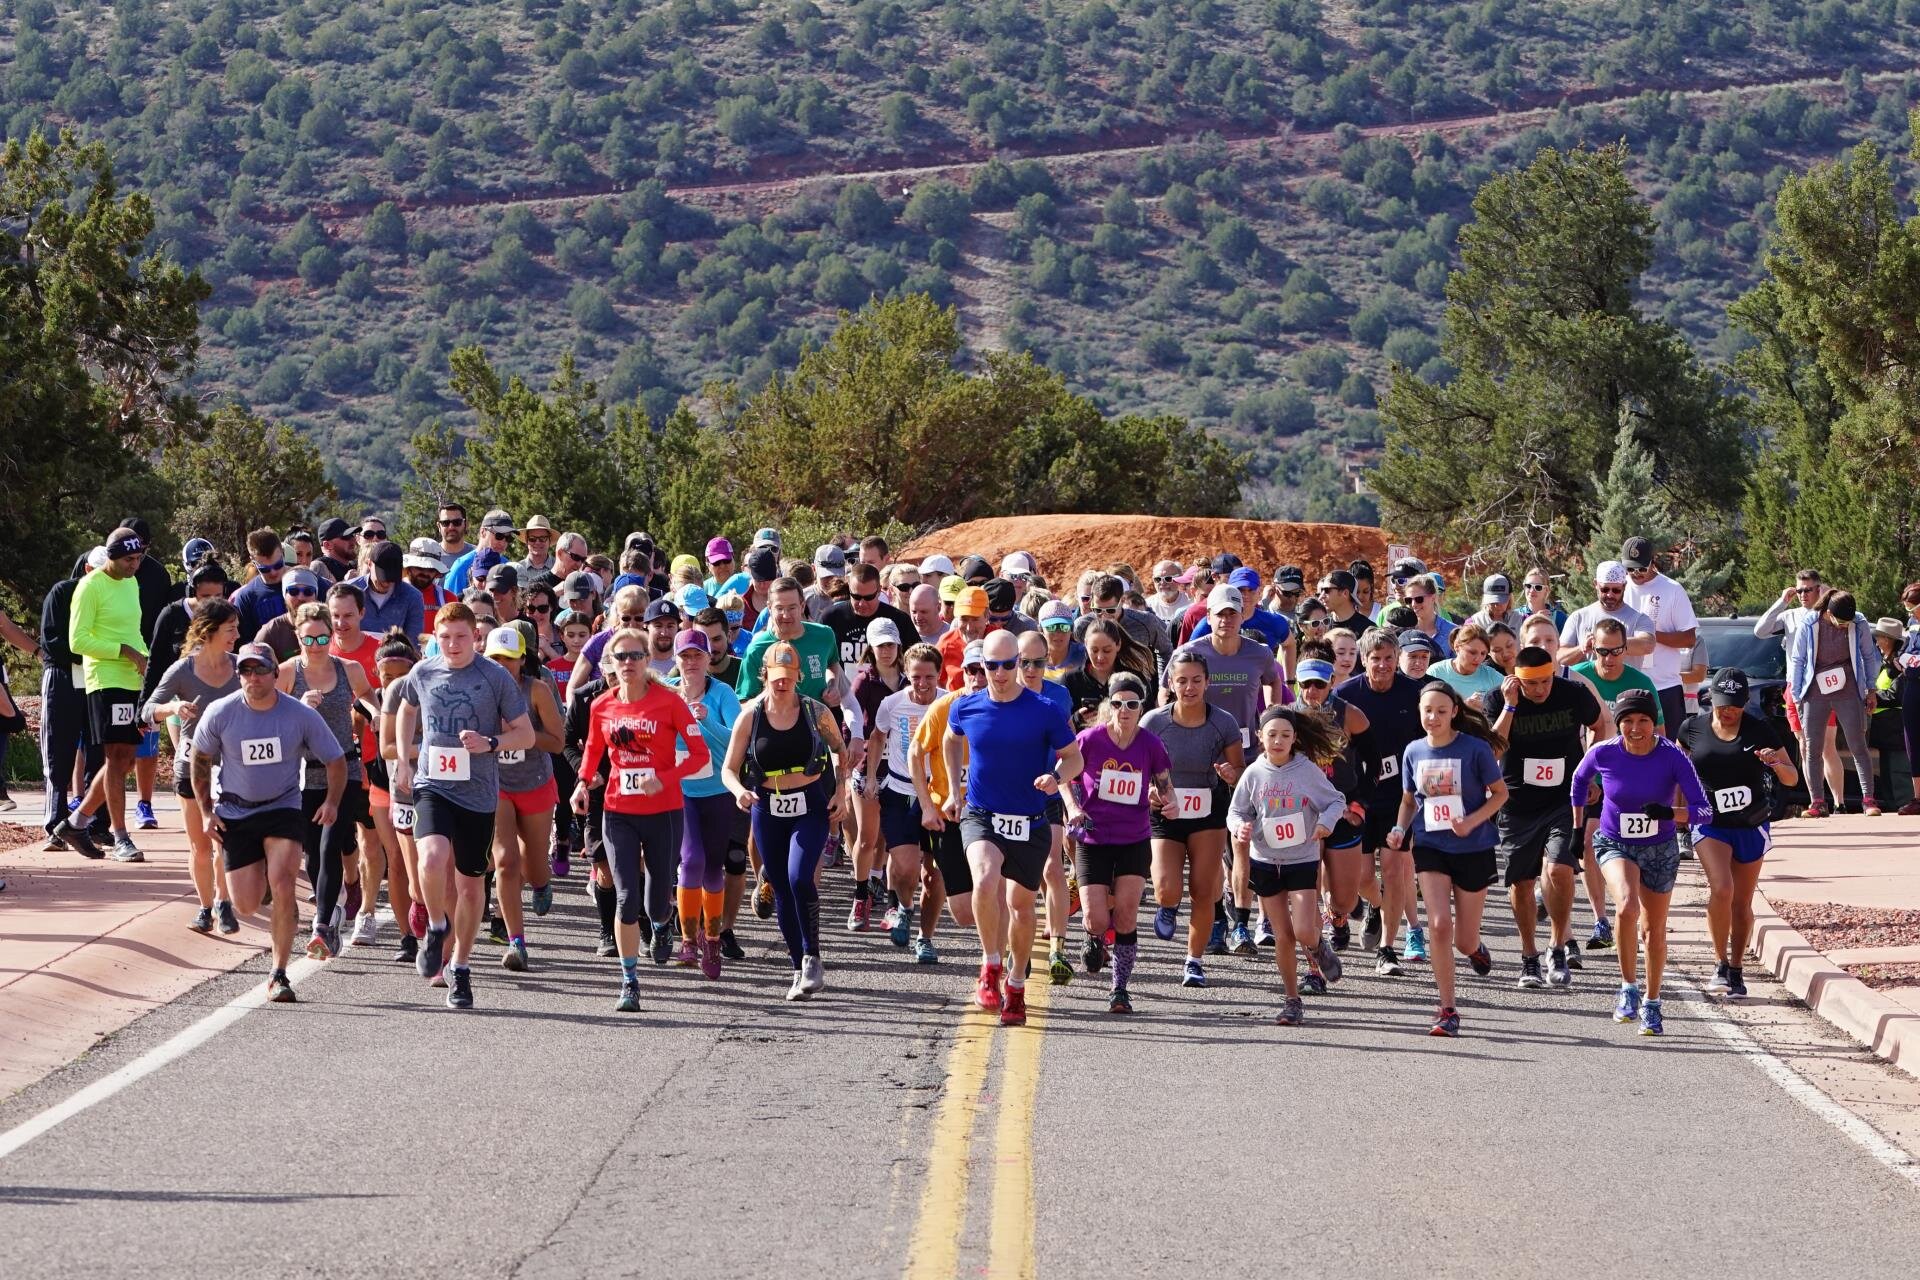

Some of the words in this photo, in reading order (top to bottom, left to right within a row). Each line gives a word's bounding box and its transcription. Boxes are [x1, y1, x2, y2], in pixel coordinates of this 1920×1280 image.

[1395, 549, 1404, 558] NO
[841, 642, 868, 662] RU
[1825, 674, 1839, 688] 69
[609, 717, 657, 734] HARBISON
[248, 743, 274, 761] 228
[439, 755, 457, 773] 34
[1535, 765, 1553, 780] 26
[1108, 778, 1136, 796] 100
[775, 797, 799, 814] 227
[1183, 795, 1201, 811] 70
[1721, 790, 1746, 809] 212
[398, 808, 414, 824] 28
[1433, 804, 1450, 822] 89
[998, 818, 1022, 837] 216
[1275, 823, 1295, 841] 90
[1627, 818, 1652, 834] 237
